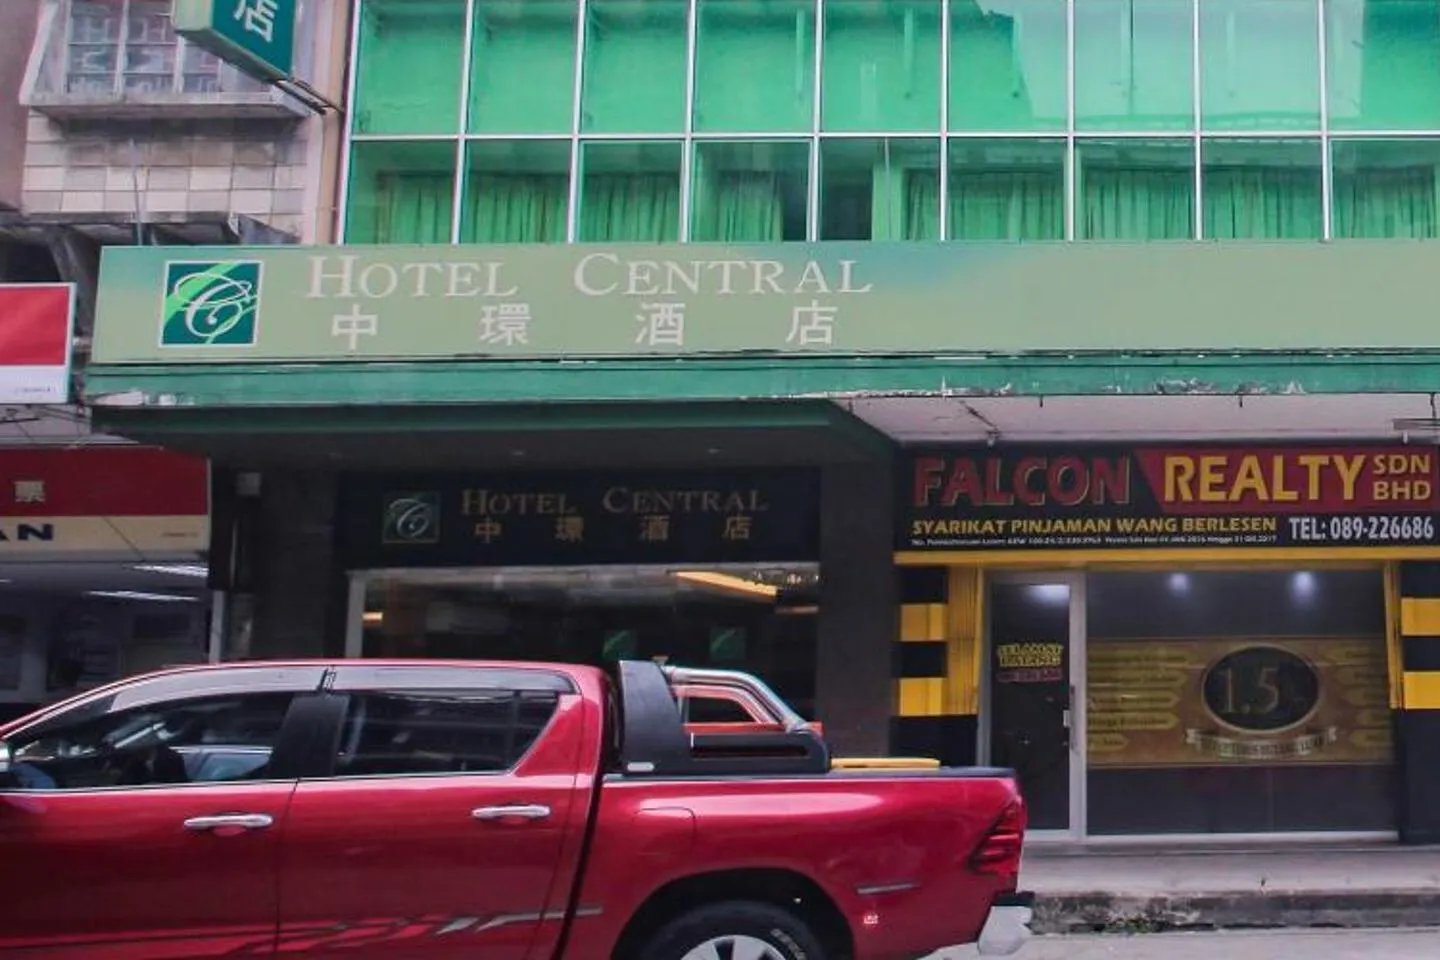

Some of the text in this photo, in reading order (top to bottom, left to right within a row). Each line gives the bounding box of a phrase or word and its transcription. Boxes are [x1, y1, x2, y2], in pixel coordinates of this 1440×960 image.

[306, 253, 874, 299] HOTEL CENTRAL
[329, 300, 839, 351] 中環酒店
[1372, 454, 1431, 474] SDN
[914, 454, 1366, 507] FALCON REALTY
[1372, 479, 1432, 501] BHD
[461, 486, 769, 516] HOTEL CENTRAL
[474, 513, 753, 543] 中環酒店
[912, 517, 1277, 535] SYARIKAT PINJAMAN WANG BERLESEN
[1289, 515, 1434, 540] TEL: 089-226686
